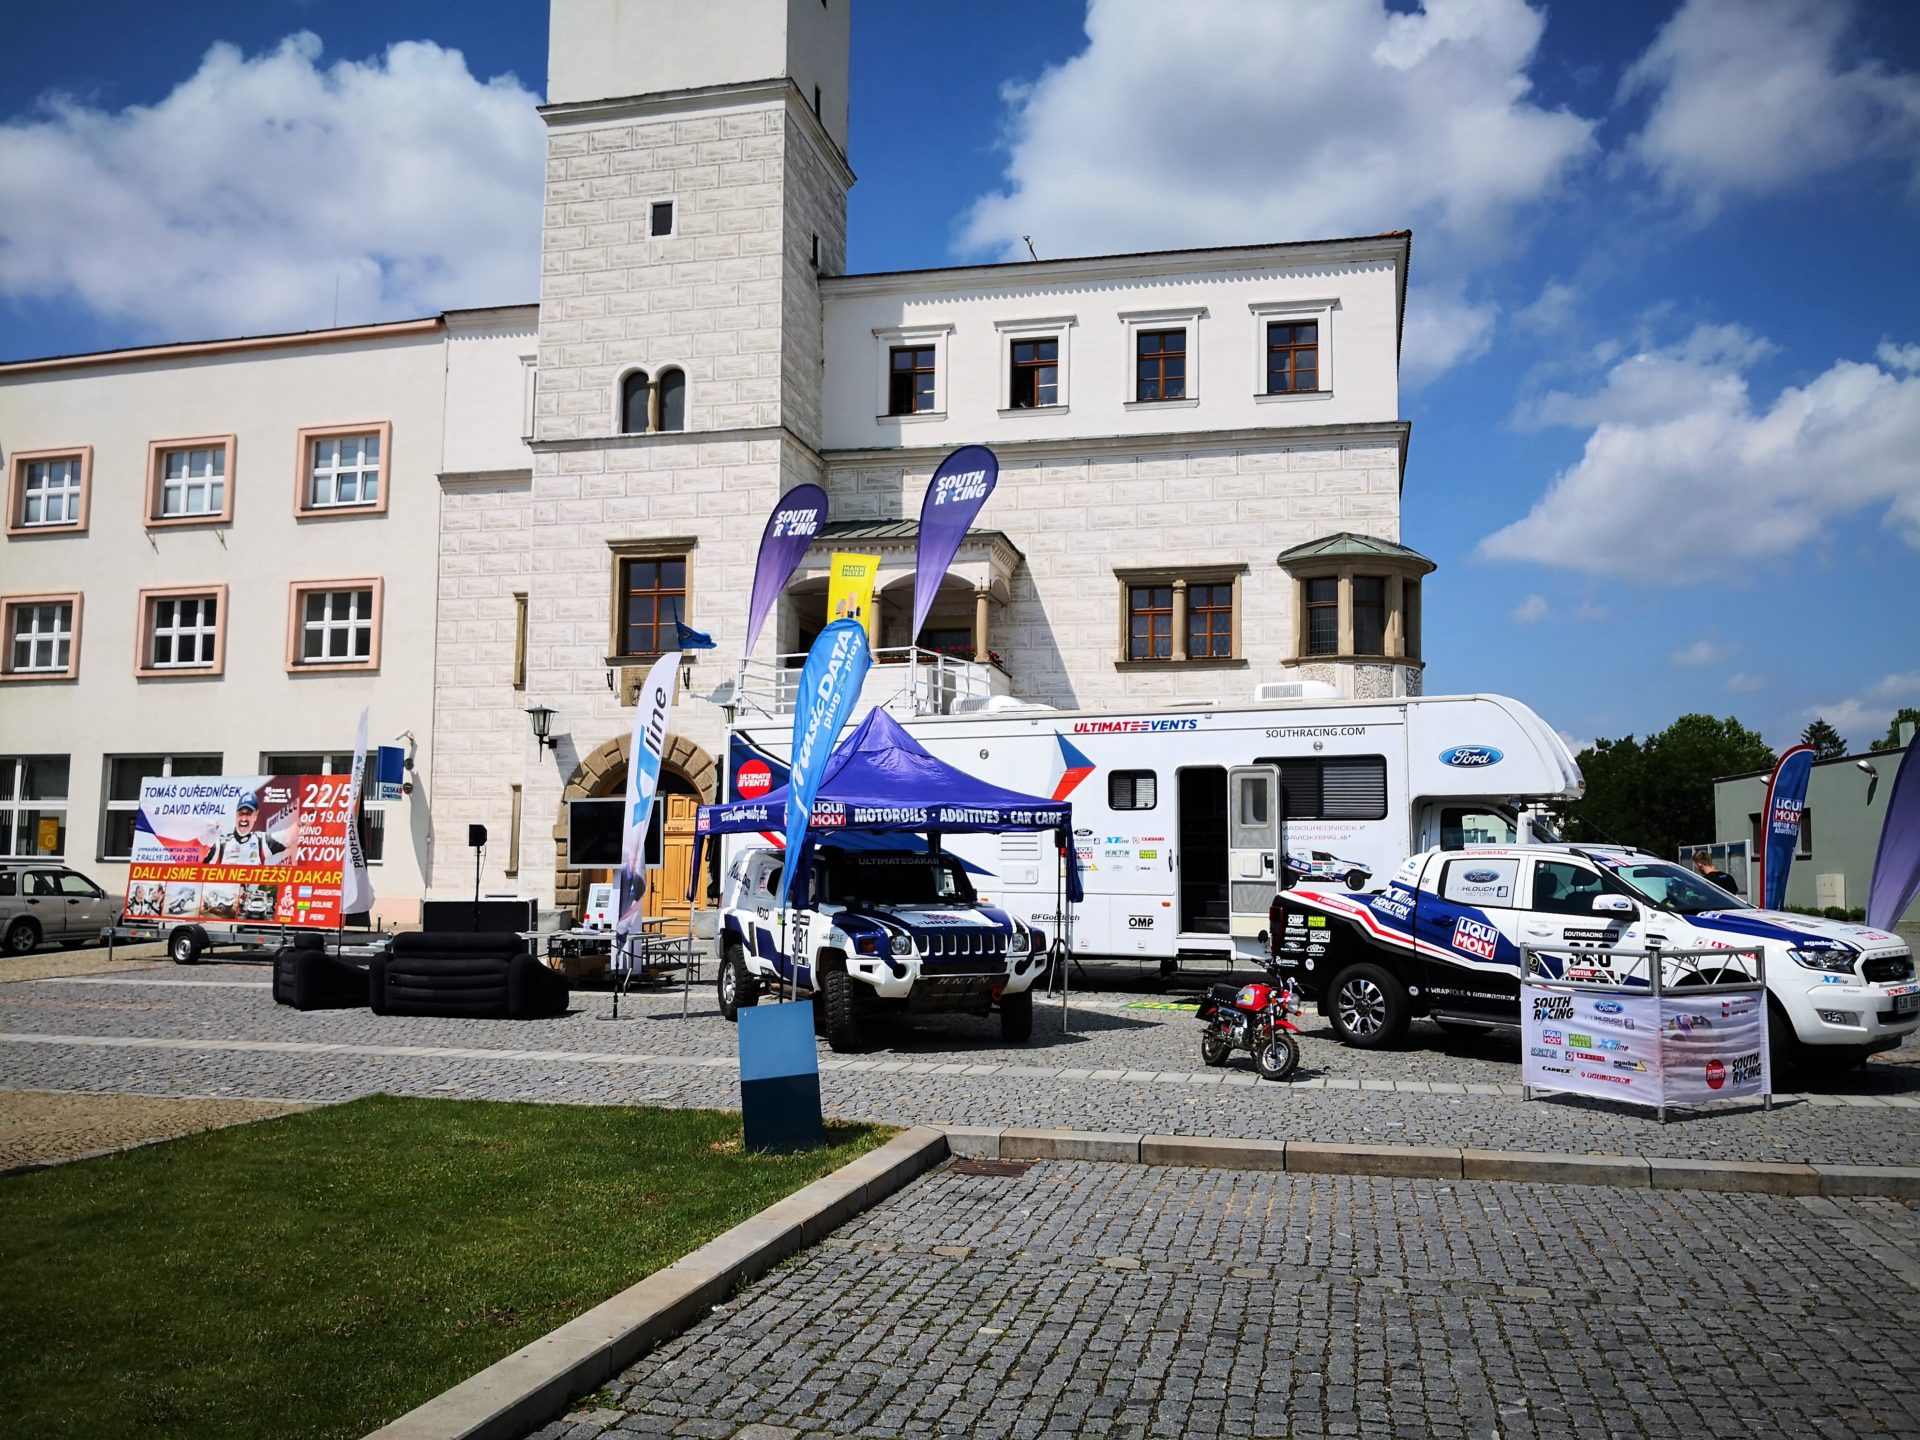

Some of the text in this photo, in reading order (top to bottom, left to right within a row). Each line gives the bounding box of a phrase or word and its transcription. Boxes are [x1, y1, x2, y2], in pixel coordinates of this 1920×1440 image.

[936, 470, 985, 491] SOUTH
[775, 509, 817, 524] SOUTH
[822, 693, 841, 730] plug
[845, 633, 863, 673] play
[1265, 727, 1366, 738] SOUTHRACING.COM
[1451, 748, 1490, 765] Ford
[738, 779, 770, 787] EVENTS
[145, 784, 242, 798] TOMÁŠ OUŘEDNÍČEK
[155, 802, 227, 815] a DAVID KŘÍPAL
[811, 802, 844, 813] LIQUI
[1776, 798, 1802, 811] LIQUI
[301, 811, 317, 823] od
[811, 813, 844, 826] MOLY
[855, 808, 1062, 825] MOTOROILS ADDITIVES CAR CARE
[1775, 810, 1801, 822] MOLY
[300, 826, 322, 835] KINO
[296, 847, 346, 862] KYJOV
[133, 866, 343, 884] DALI JSME TEN NEJTĚŽŠÍ DAKAR
[1469, 872, 1492, 881] Ford
[1381, 885, 1417, 908] XTline
[1128, 917, 1154, 927] OMP
[1459, 920, 1496, 943] LIQUI
[1564, 930, 1618, 939] SOUTHRACING.COM
[1456, 933, 1494, 957] MOLY
[1533, 996, 1571, 1009] SOUTH
[1598, 1003, 1618, 1013] Ford
[1543, 1037, 1561, 1045] MOLY
[1732, 1052, 1760, 1073] SOUTH
